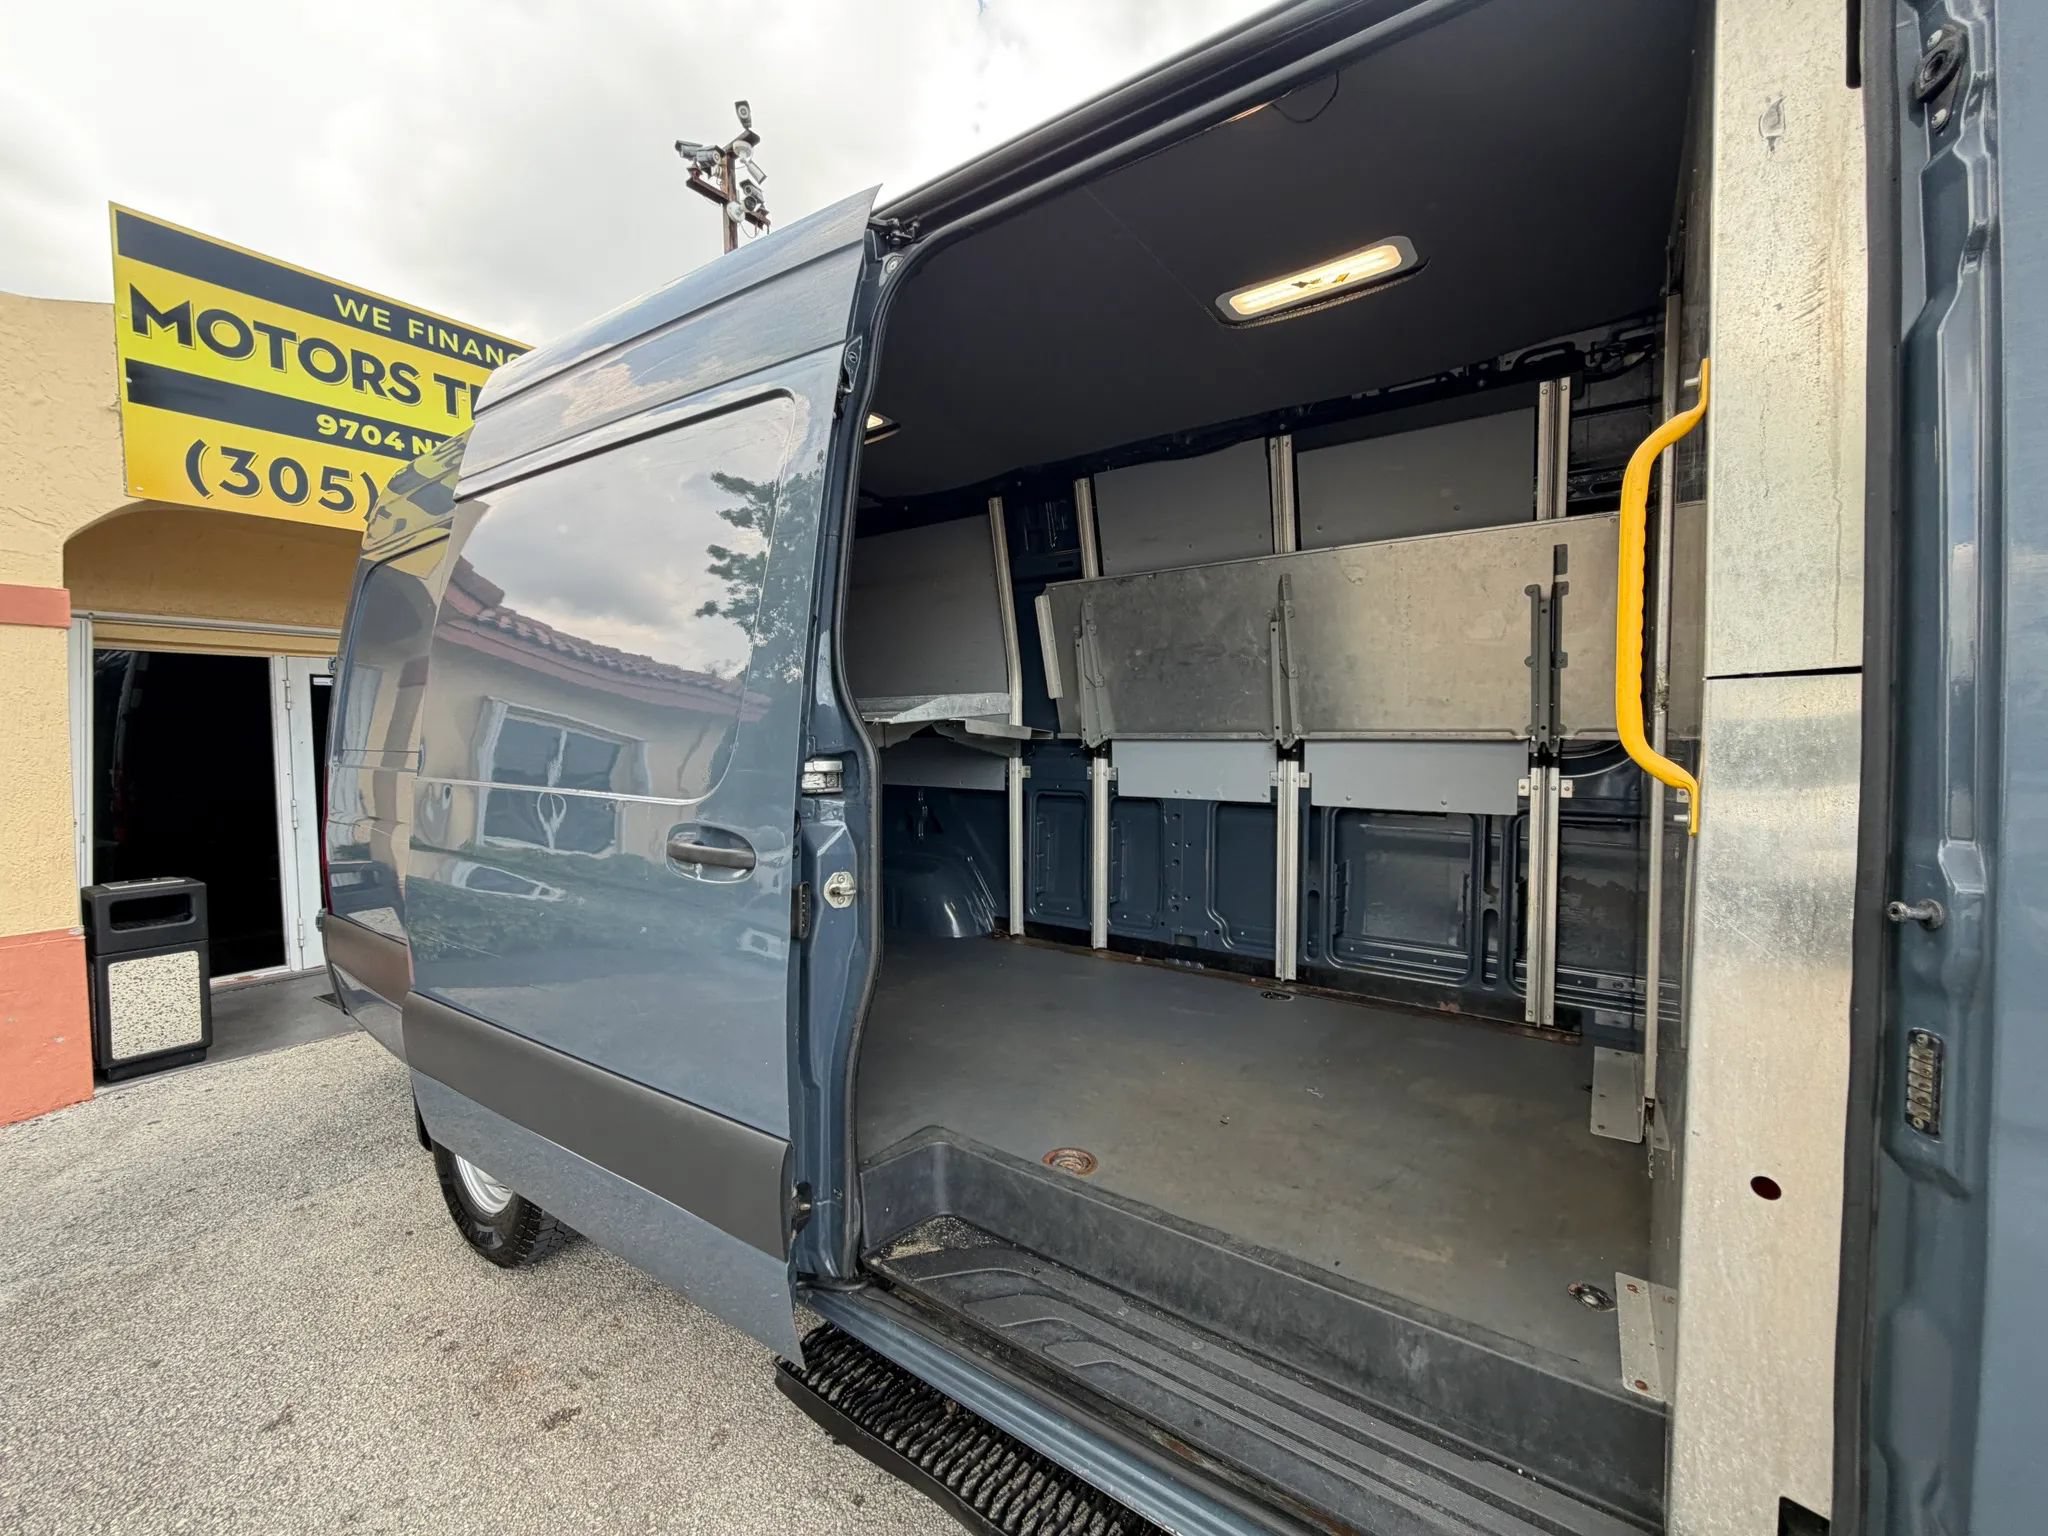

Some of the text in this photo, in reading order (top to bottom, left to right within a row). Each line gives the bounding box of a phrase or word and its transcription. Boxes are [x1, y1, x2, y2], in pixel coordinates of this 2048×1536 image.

[333, 293, 392, 333] WE
[129, 282, 422, 407] MOTORS
[316, 414, 442, 456] 9704 N
[185, 439, 380, 522] (305)
